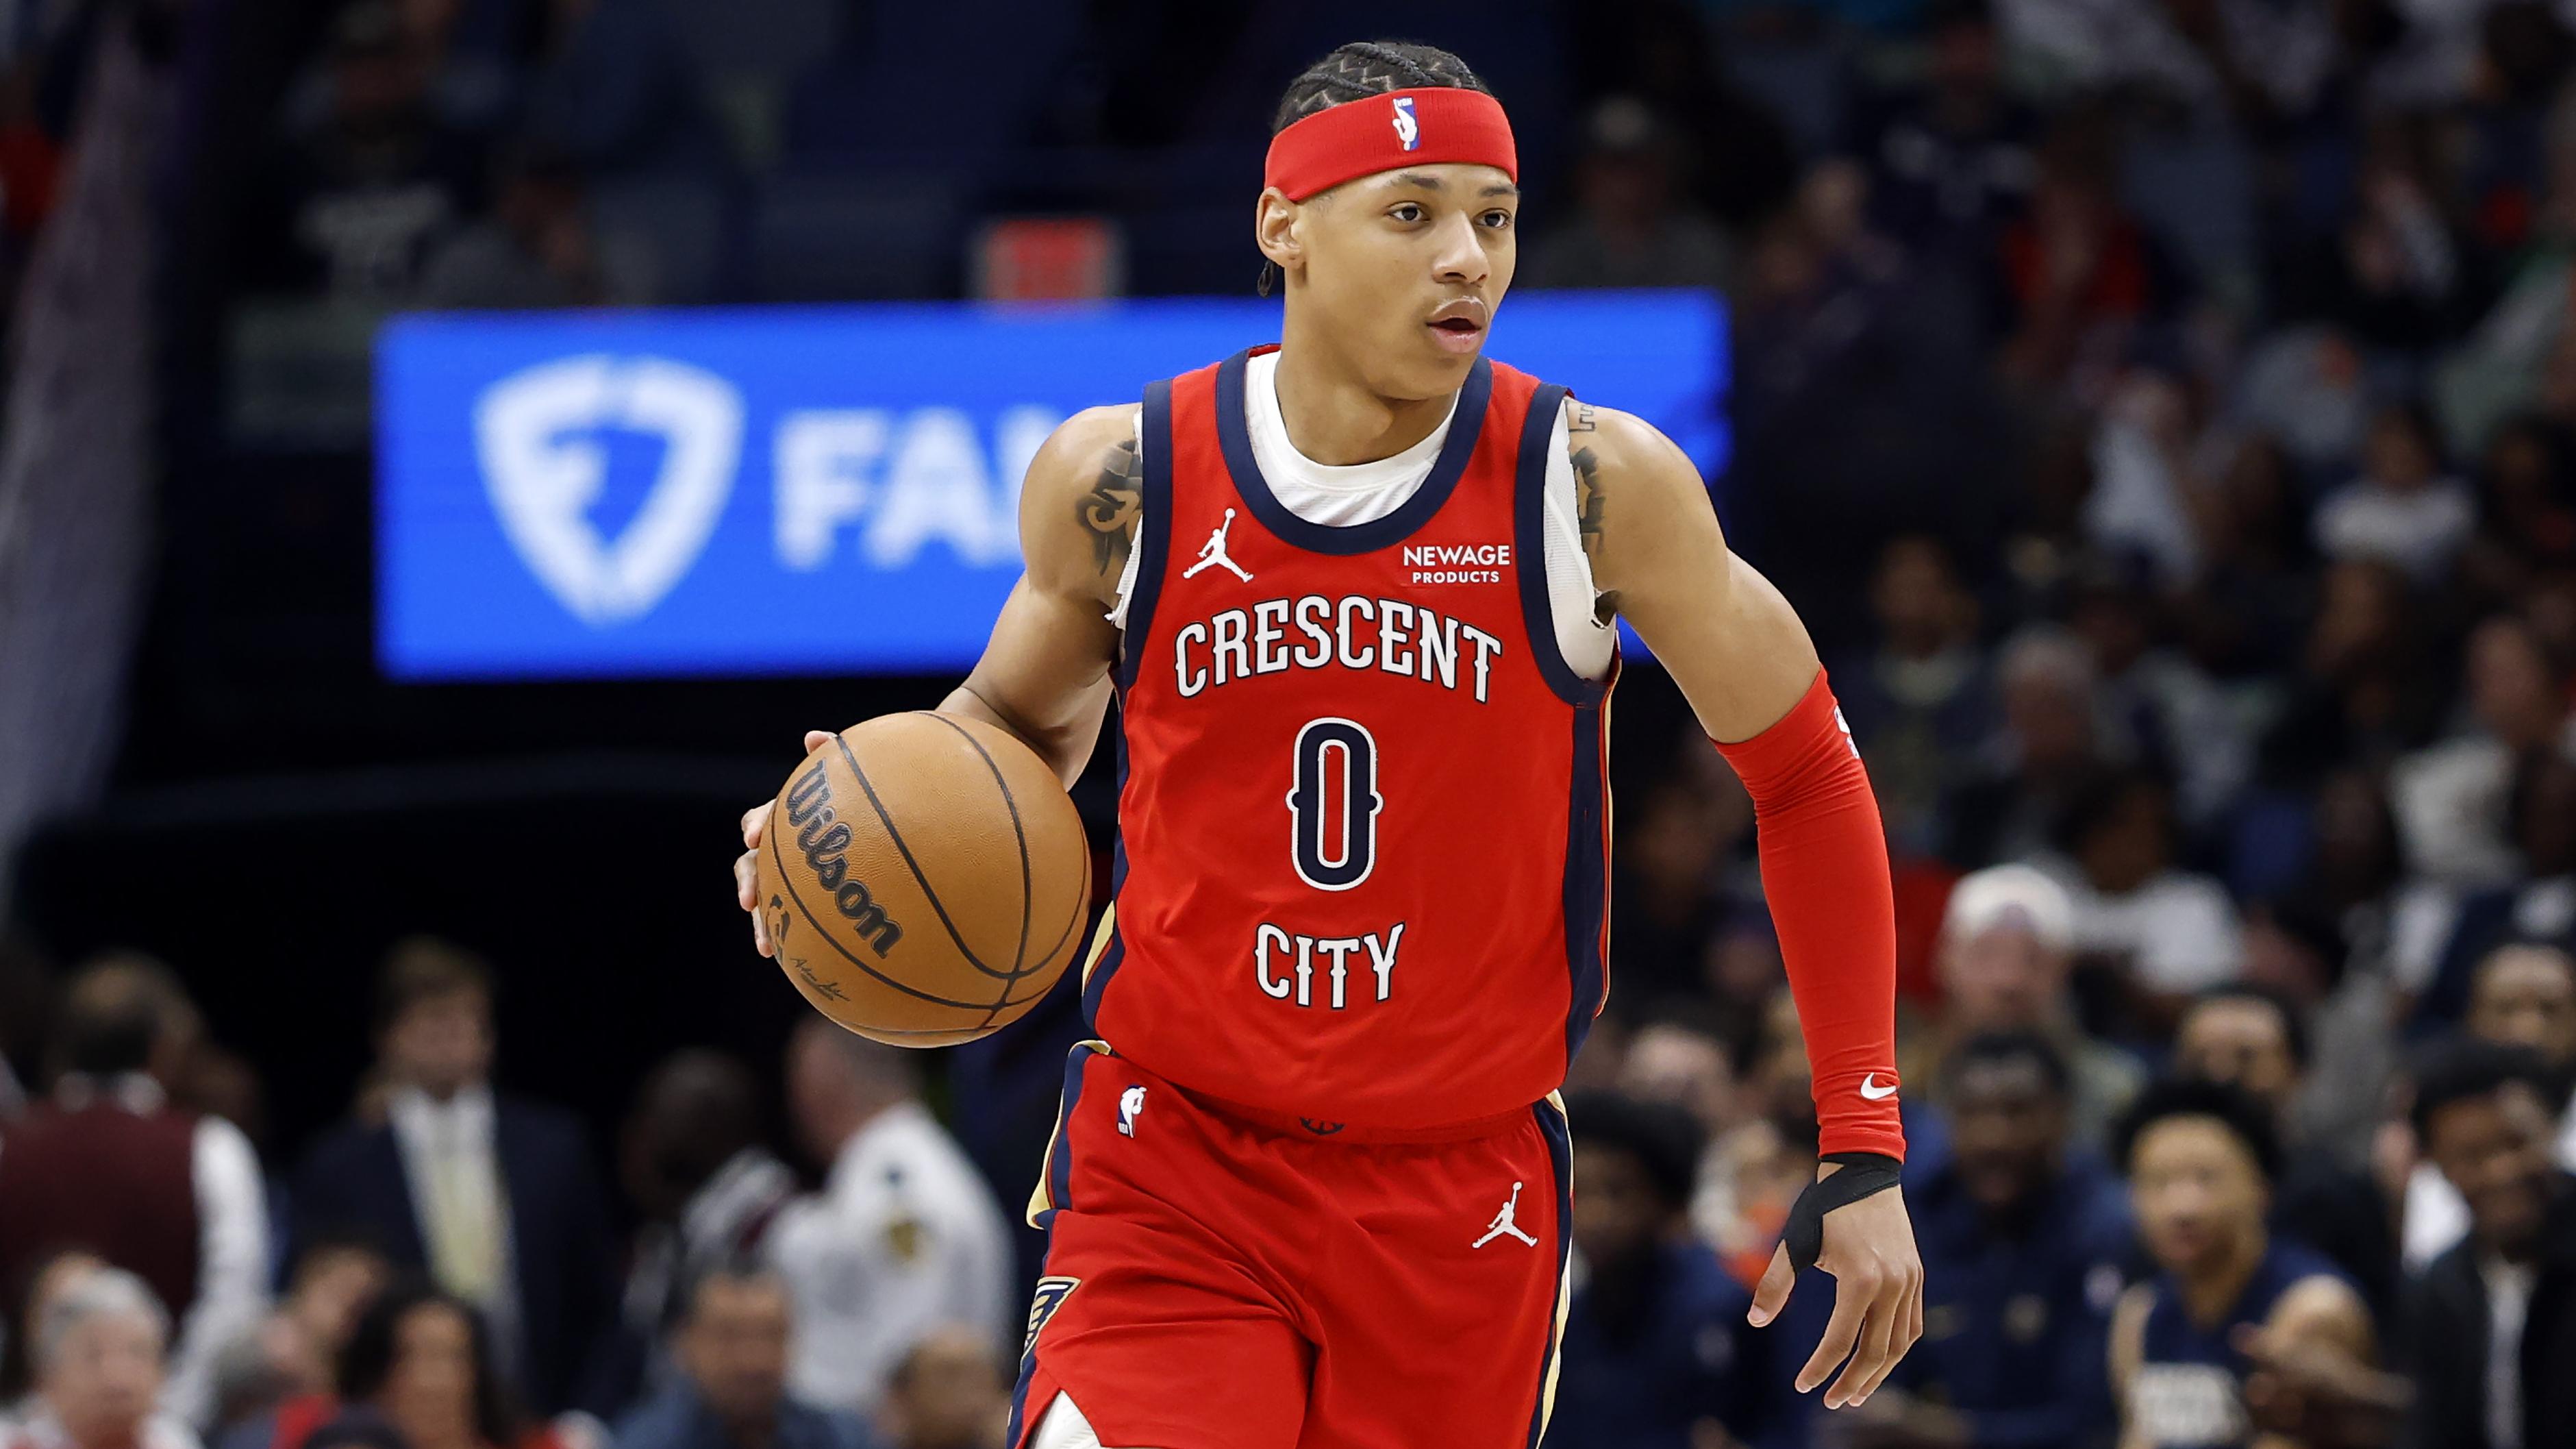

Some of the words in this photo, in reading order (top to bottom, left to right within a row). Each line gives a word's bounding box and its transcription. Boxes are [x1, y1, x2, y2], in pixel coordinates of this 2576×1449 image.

[1403, 545, 1510, 567] NEWAGE
[1412, 571, 1499, 584] PRODUCTS
[1175, 594, 1502, 704] CRESCENT
[1286, 717, 1384, 891] 0
[786, 756, 903, 959] Wilson
[1255, 921, 1405, 1009] CITY
